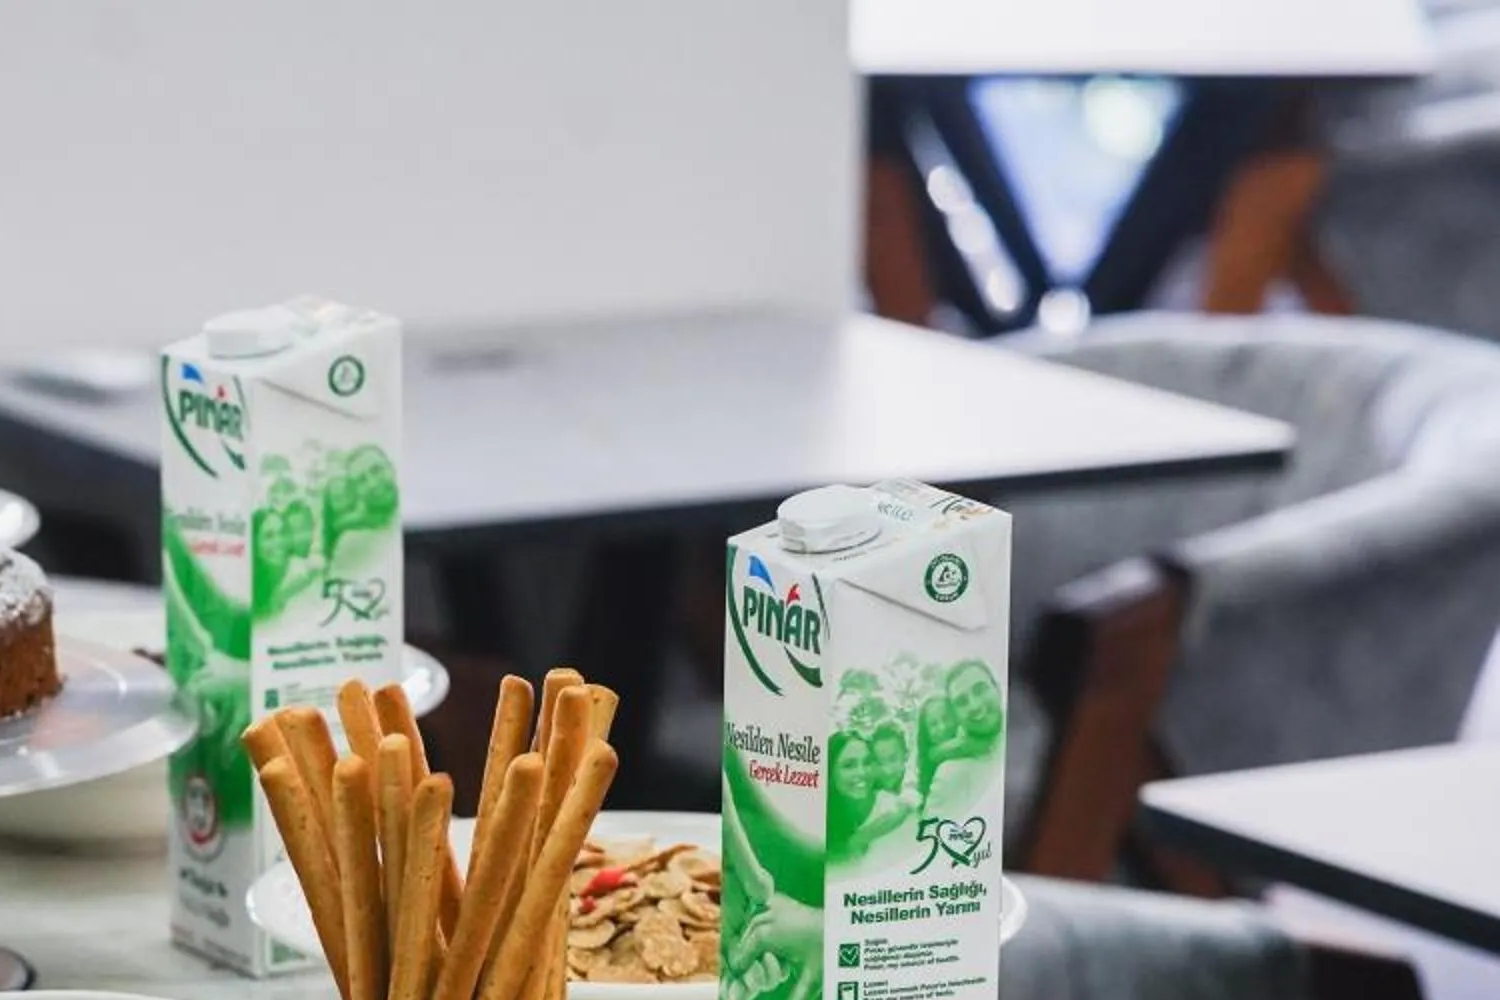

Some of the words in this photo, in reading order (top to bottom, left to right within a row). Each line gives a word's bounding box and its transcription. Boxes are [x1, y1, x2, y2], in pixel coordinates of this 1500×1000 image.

[743, 585, 821, 655] PINAR
[777, 731, 821, 765] Nesile
[843, 887, 924, 908] Nesillerin
[929, 880, 987, 900] Sağlığı,
[851, 905, 931, 925] Nesillerin
